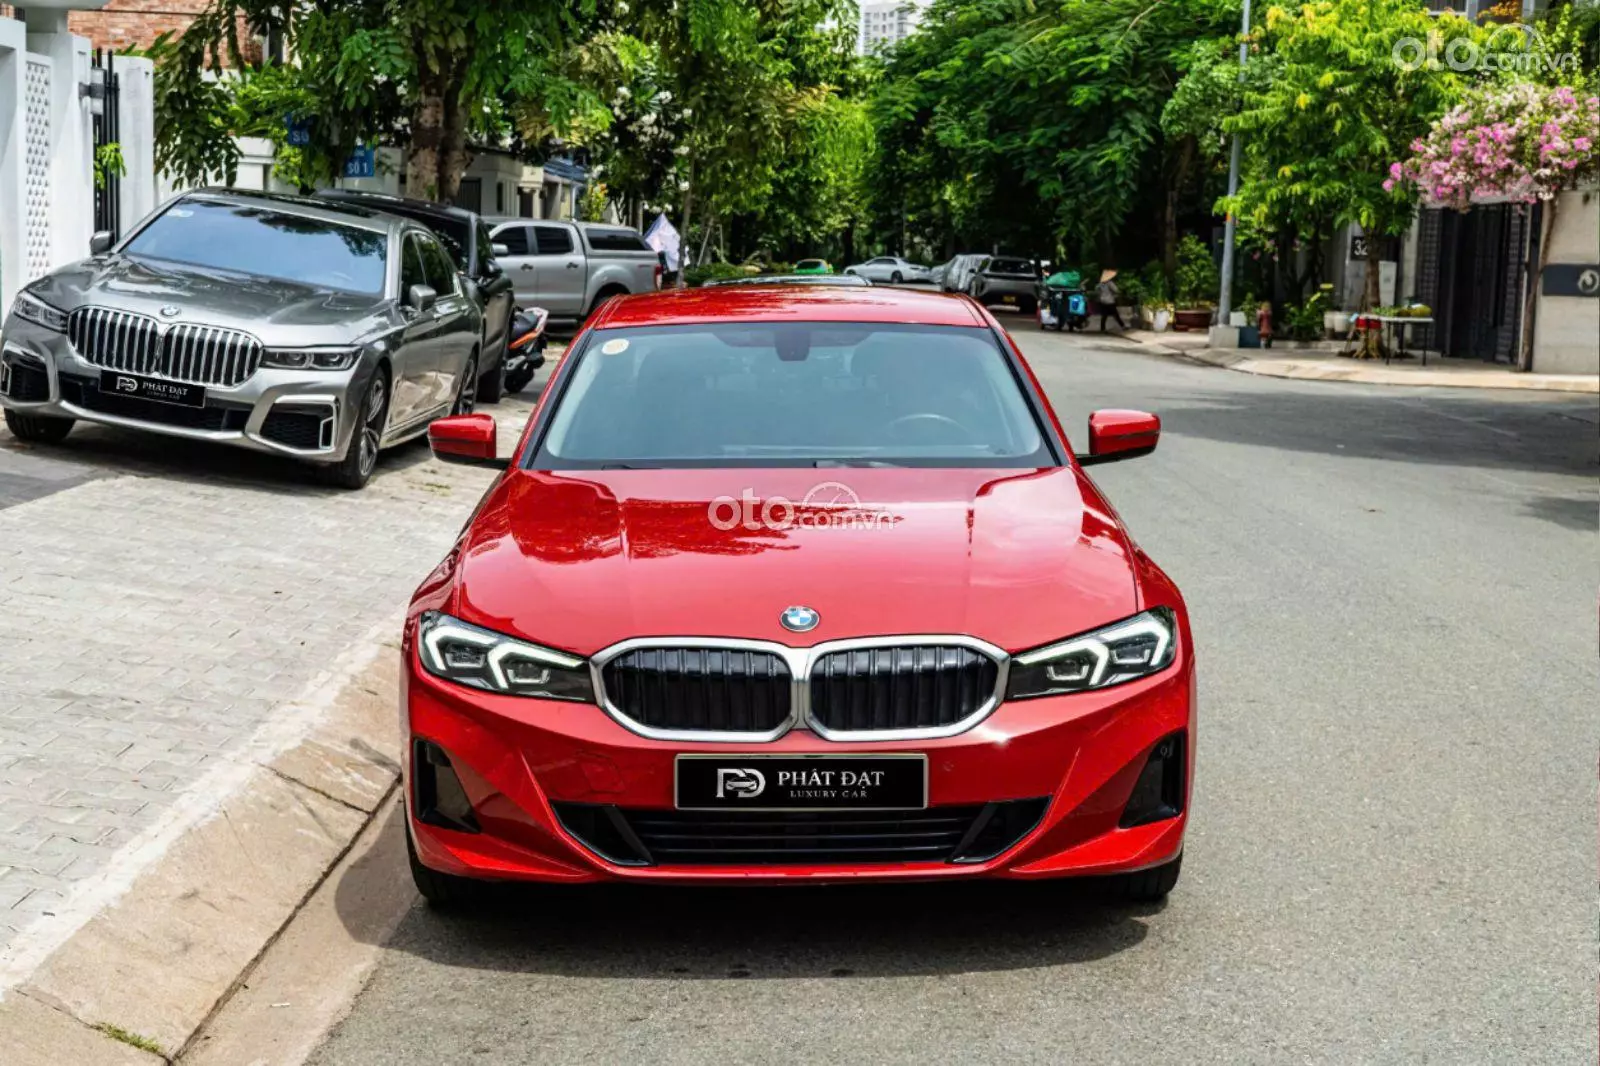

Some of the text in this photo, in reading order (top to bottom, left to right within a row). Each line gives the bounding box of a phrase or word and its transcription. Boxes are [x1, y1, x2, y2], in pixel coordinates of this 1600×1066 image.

[362, 161, 368, 174] 1
[840, 771, 885, 789] ĐẠT
[790, 790, 867, 798] LUXURY CAR
